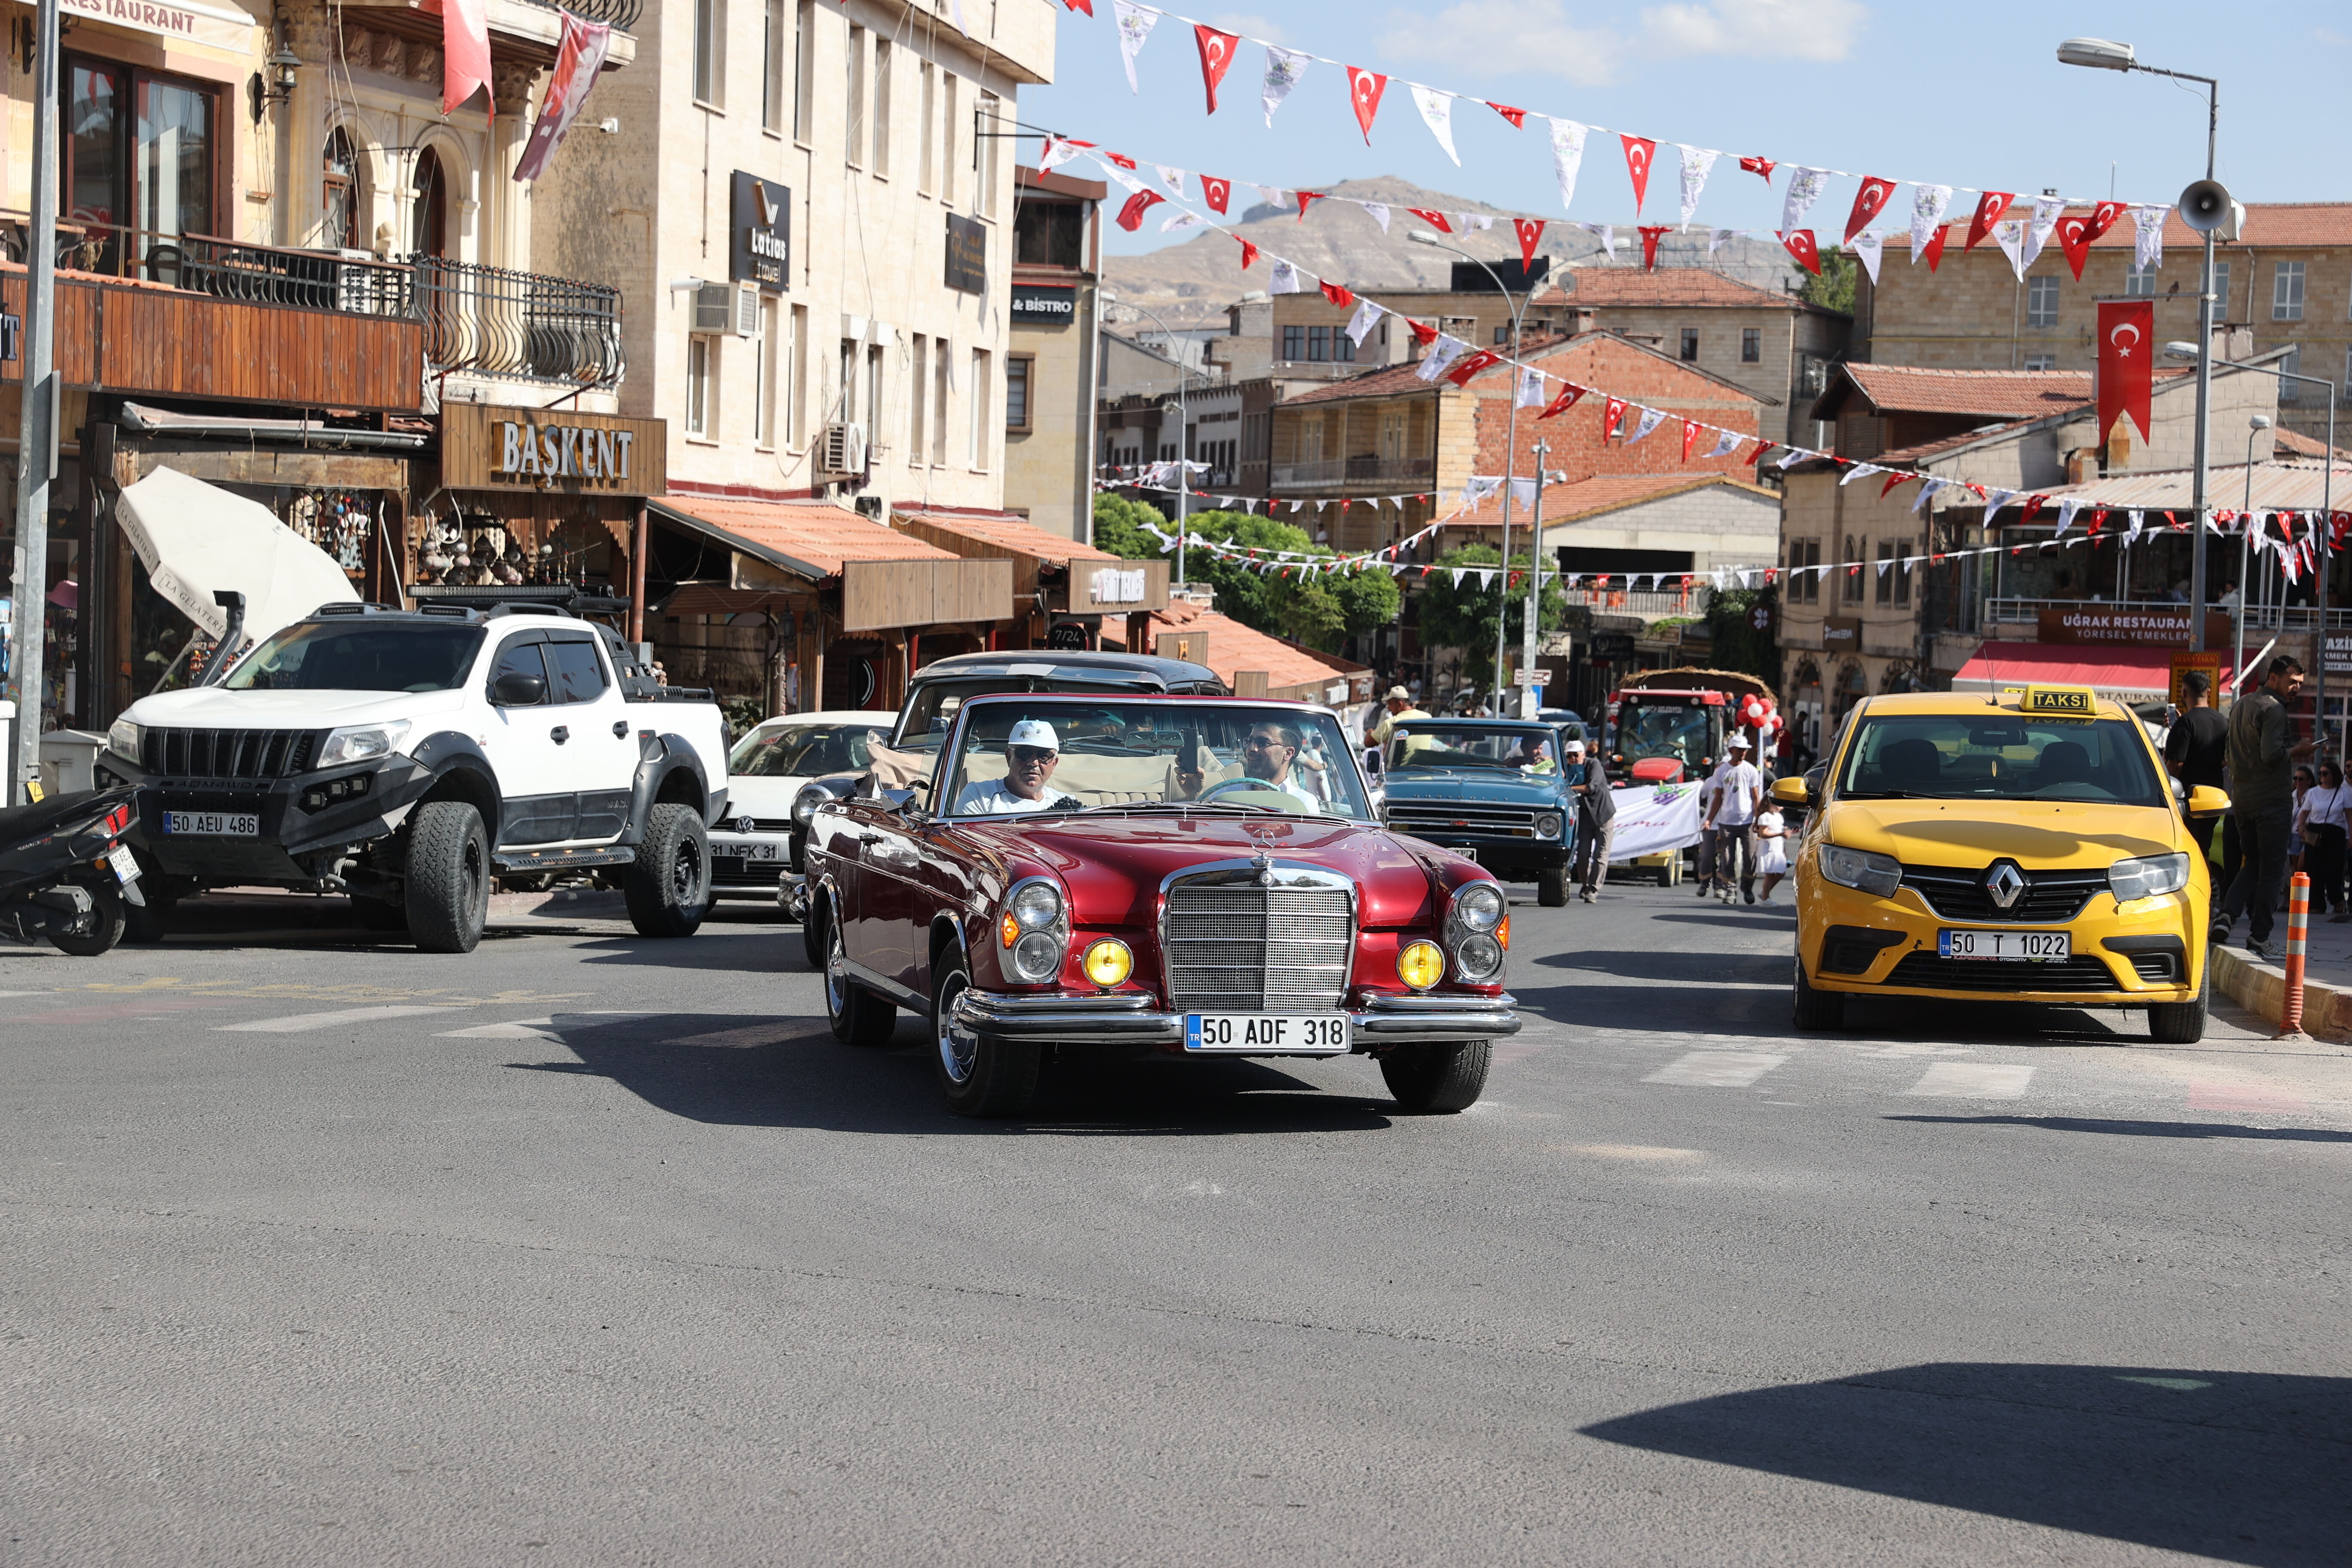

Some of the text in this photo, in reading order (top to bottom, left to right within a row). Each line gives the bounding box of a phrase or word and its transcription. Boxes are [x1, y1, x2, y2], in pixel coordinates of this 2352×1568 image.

[752, 227, 786, 261] Latias
[1012, 296, 1072, 313] & BİSTRO
[502, 421, 633, 489] BAŞKENT
[121, 509, 151, 561] LA GELATERIA
[166, 581, 177, 594] LA
[2063, 612, 2191, 629] UĞRAK RESTAURAN
[1056, 629, 1079, 643] 7/24
[2076, 629, 2127, 640] YÖRESEL
[2317, 652, 2348, 660] KMEK
[2096, 691, 2168, 701] STAURANT
[173, 816, 189, 831] 50
[197, 816, 222, 832] AEU
[230, 817, 255, 833] 486
[111, 849, 131, 868] 50 AEJ
[764, 846, 776, 859] 31
[126, 861, 137, 875] 648
[1952, 934, 1975, 953] 50
[1994, 935, 2003, 954] T
[2021, 935, 2065, 956] 1022
[1204, 1019, 1231, 1044] 50
[1245, 1019, 1288, 1044] ADF
[1304, 1020, 1343, 1045] 318
